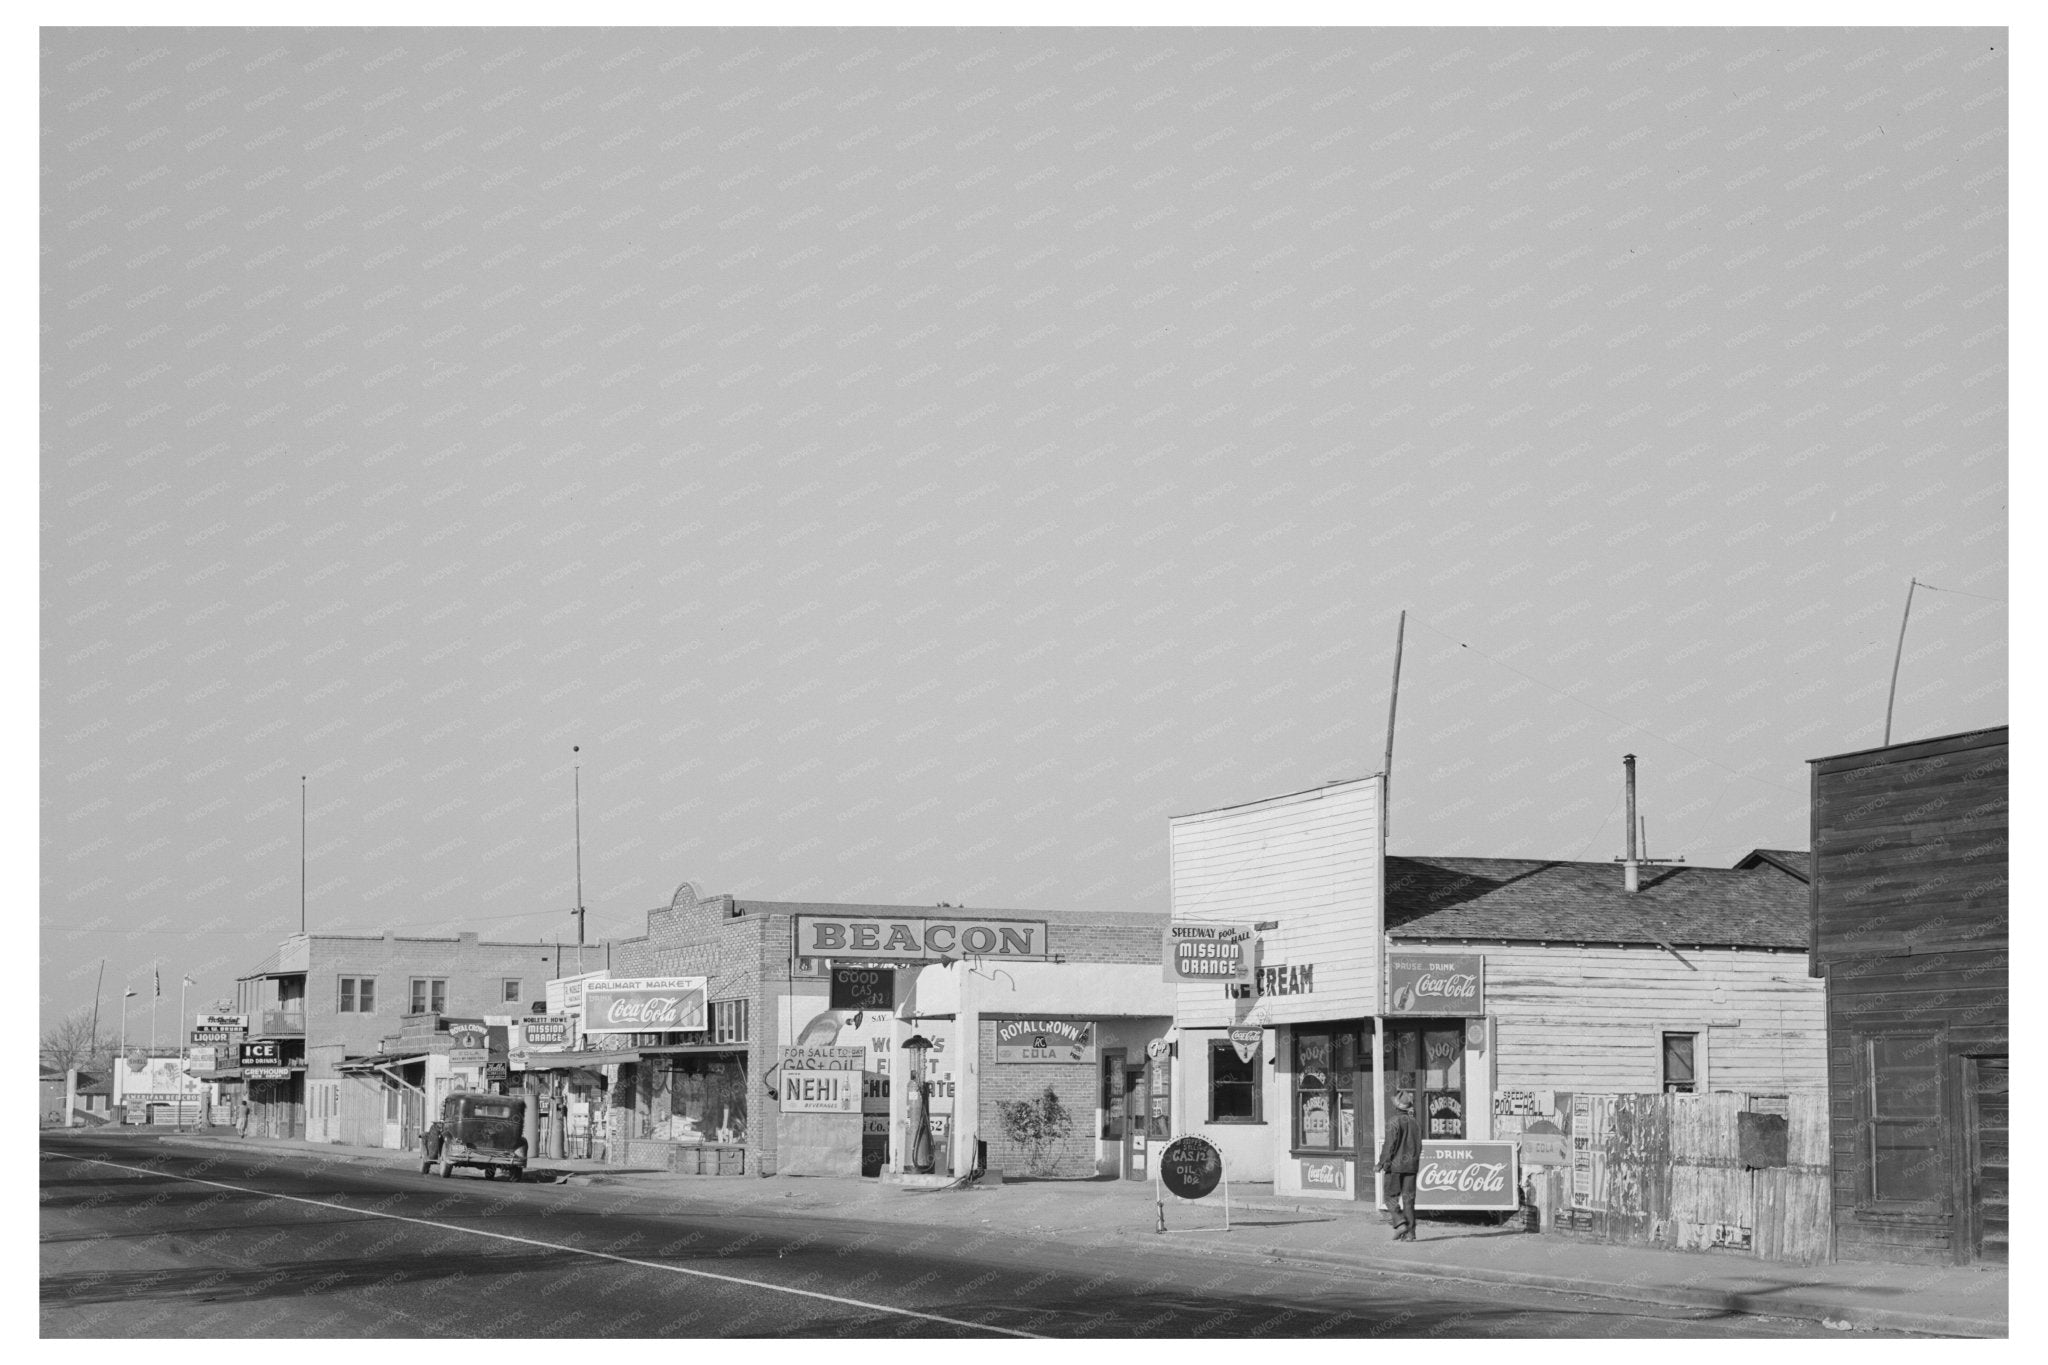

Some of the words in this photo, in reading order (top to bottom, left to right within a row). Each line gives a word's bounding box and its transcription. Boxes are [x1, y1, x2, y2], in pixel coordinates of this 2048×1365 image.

[812, 922, 1034, 954] BEACON
[1171, 927, 1216, 938] SPEEDWAY
[1218, 927, 1236, 940] POOL
[1231, 931, 1251, 944] HALL
[1179, 942, 1239, 958] MISSION
[1181, 958, 1236, 975] ORANGE
[587, 981, 642, 990] EARLIMART
[646, 980, 692, 988] MARKET
[838, 970, 879, 985] GOOD
[1256, 963, 1313, 997] CREAM
[1415, 973, 1478, 997] Coca-Cola
[608, 997, 680, 1024] Coca-Cola
[871, 1014, 887, 1023] SAY
[193, 1033, 227, 1041] LIQUOR
[527, 1024, 564, 1034] MISSION
[1000, 1021, 1038, 1042] ROYAL
[1038, 1021, 1079, 1041] CROWN
[529, 1033, 562, 1042] ORANGE
[245, 1045, 274, 1056] ICE
[784, 1048, 804, 1057] FOR
[807, 1048, 835, 1058] SALE
[1022, 1048, 1057, 1059] COLA
[786, 1078, 838, 1101] NEHI
[1303, 1116, 1329, 1132] BEER
[1430, 1118, 1461, 1135] BEER
[1574, 1137, 1589, 1150] SEPT
[1176, 1165, 1195, 1175] OIL
[1416, 1162, 1508, 1192] Coca-Cola
